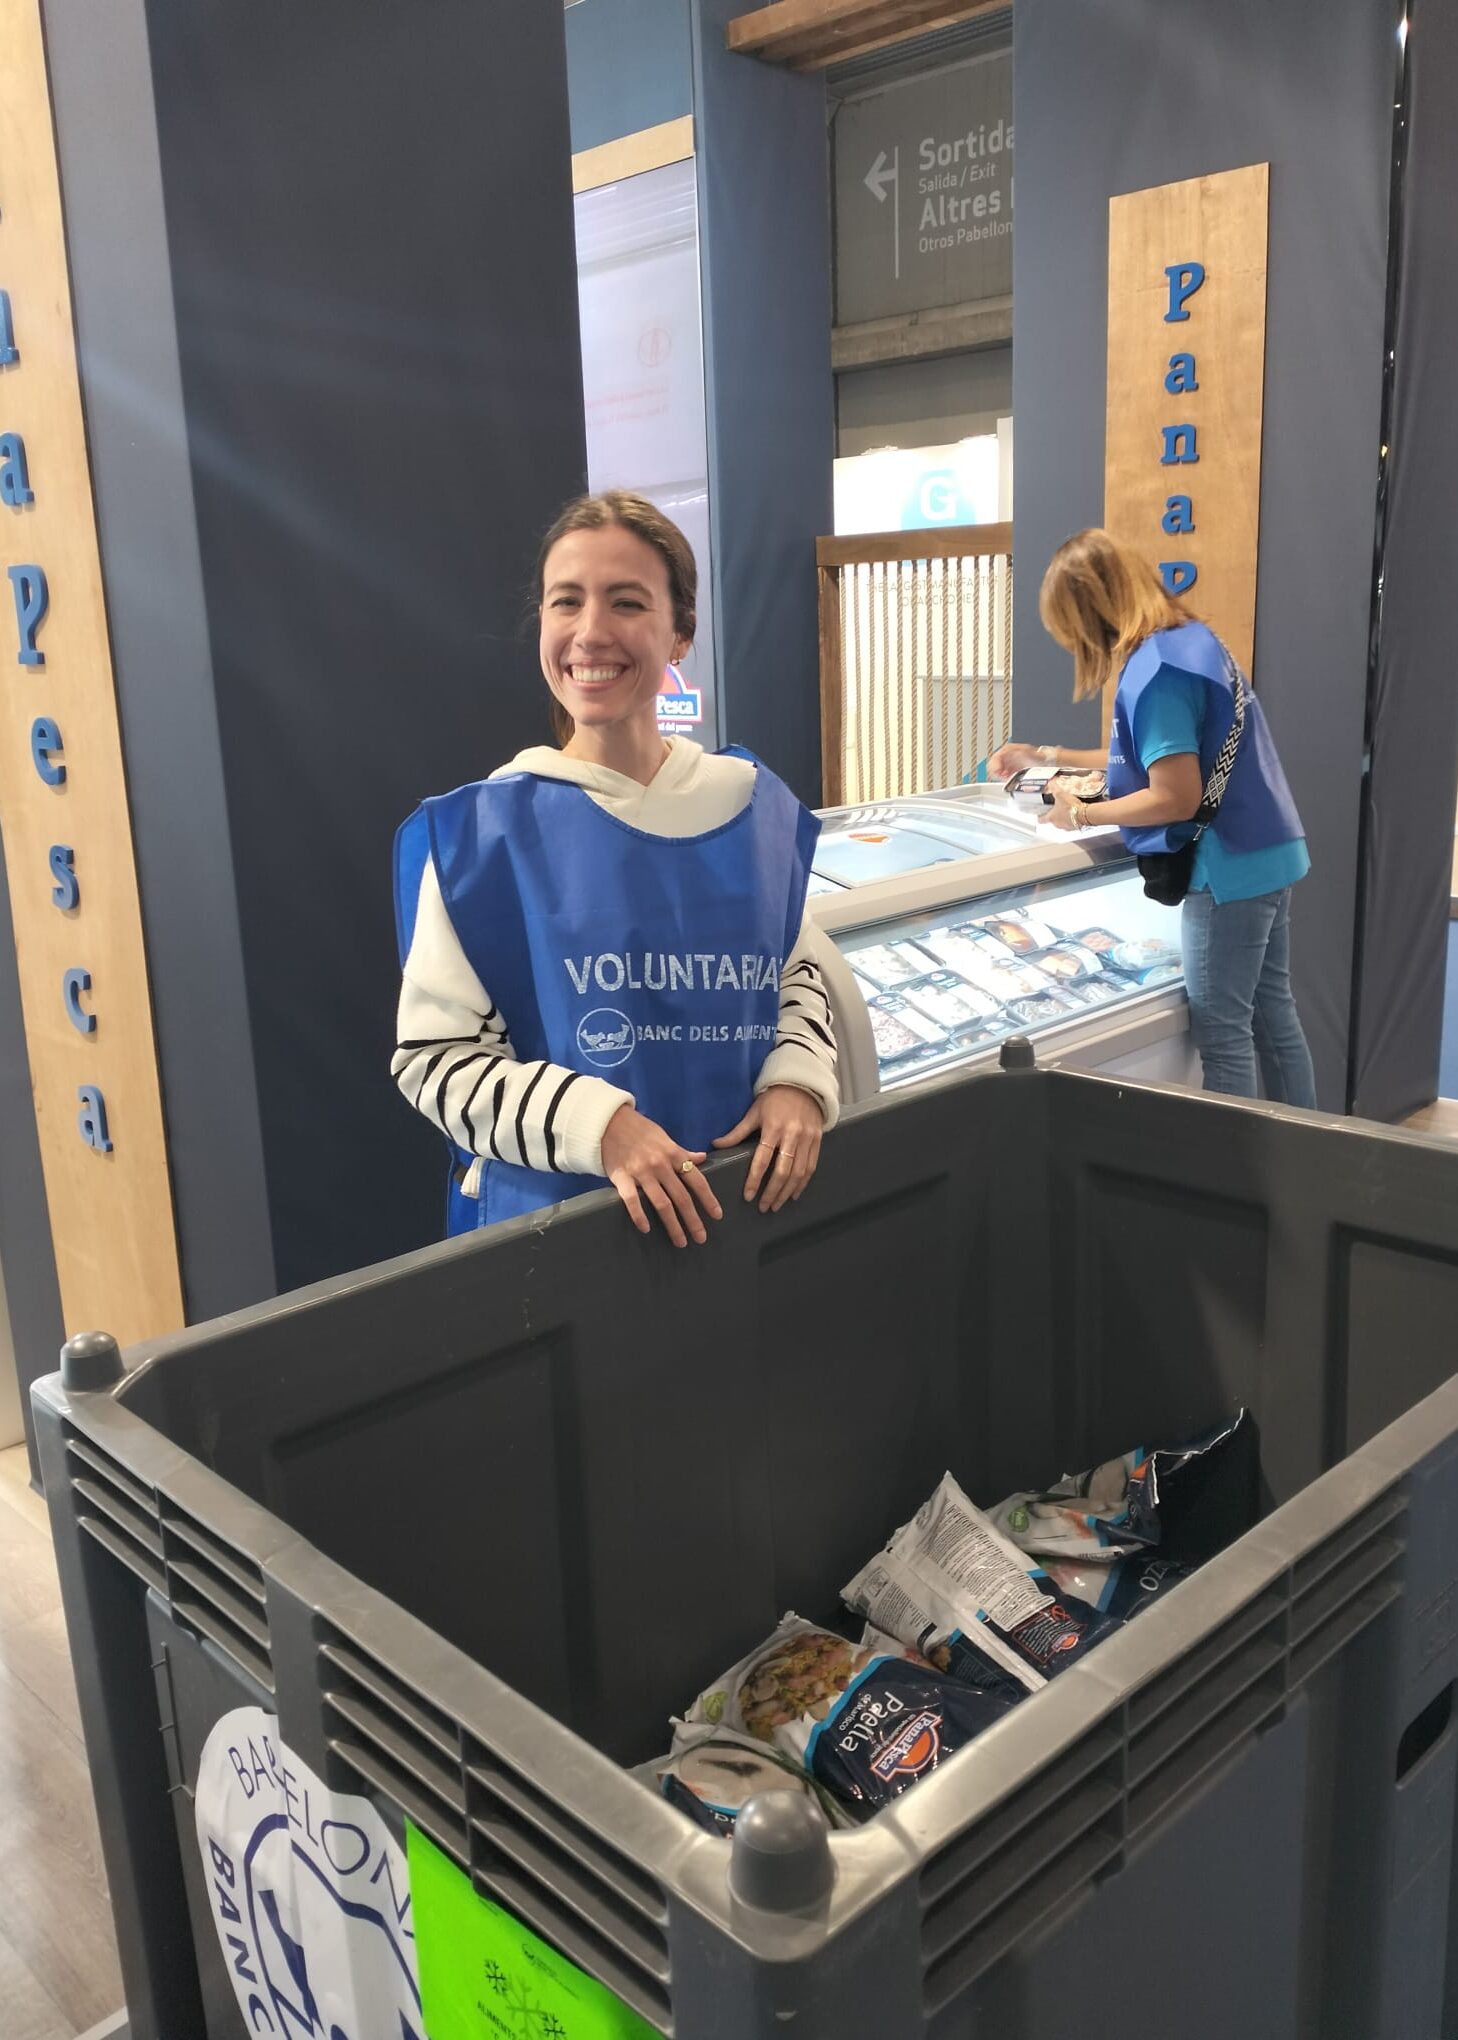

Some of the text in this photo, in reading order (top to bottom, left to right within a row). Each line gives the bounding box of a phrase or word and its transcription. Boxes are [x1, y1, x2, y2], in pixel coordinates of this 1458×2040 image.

[919, 119, 1015, 171] Sortida
[919, 176, 957, 194] Salida
[970, 162, 996, 182] Exit
[919, 190, 1001, 231] Altres
[919, 220, 1013, 253] Otros Pabellon
[920, 475, 958, 521] G
[564, 952, 783, 994] VOLUNTARIA
[636, 1024, 682, 1042] BANC
[689, 1025, 729, 1042] DELS
[839, 1691, 904, 1752] Paella
[878, 1717, 933, 1770] PanaPesca
[207, 1835, 275, 2033] BANC
